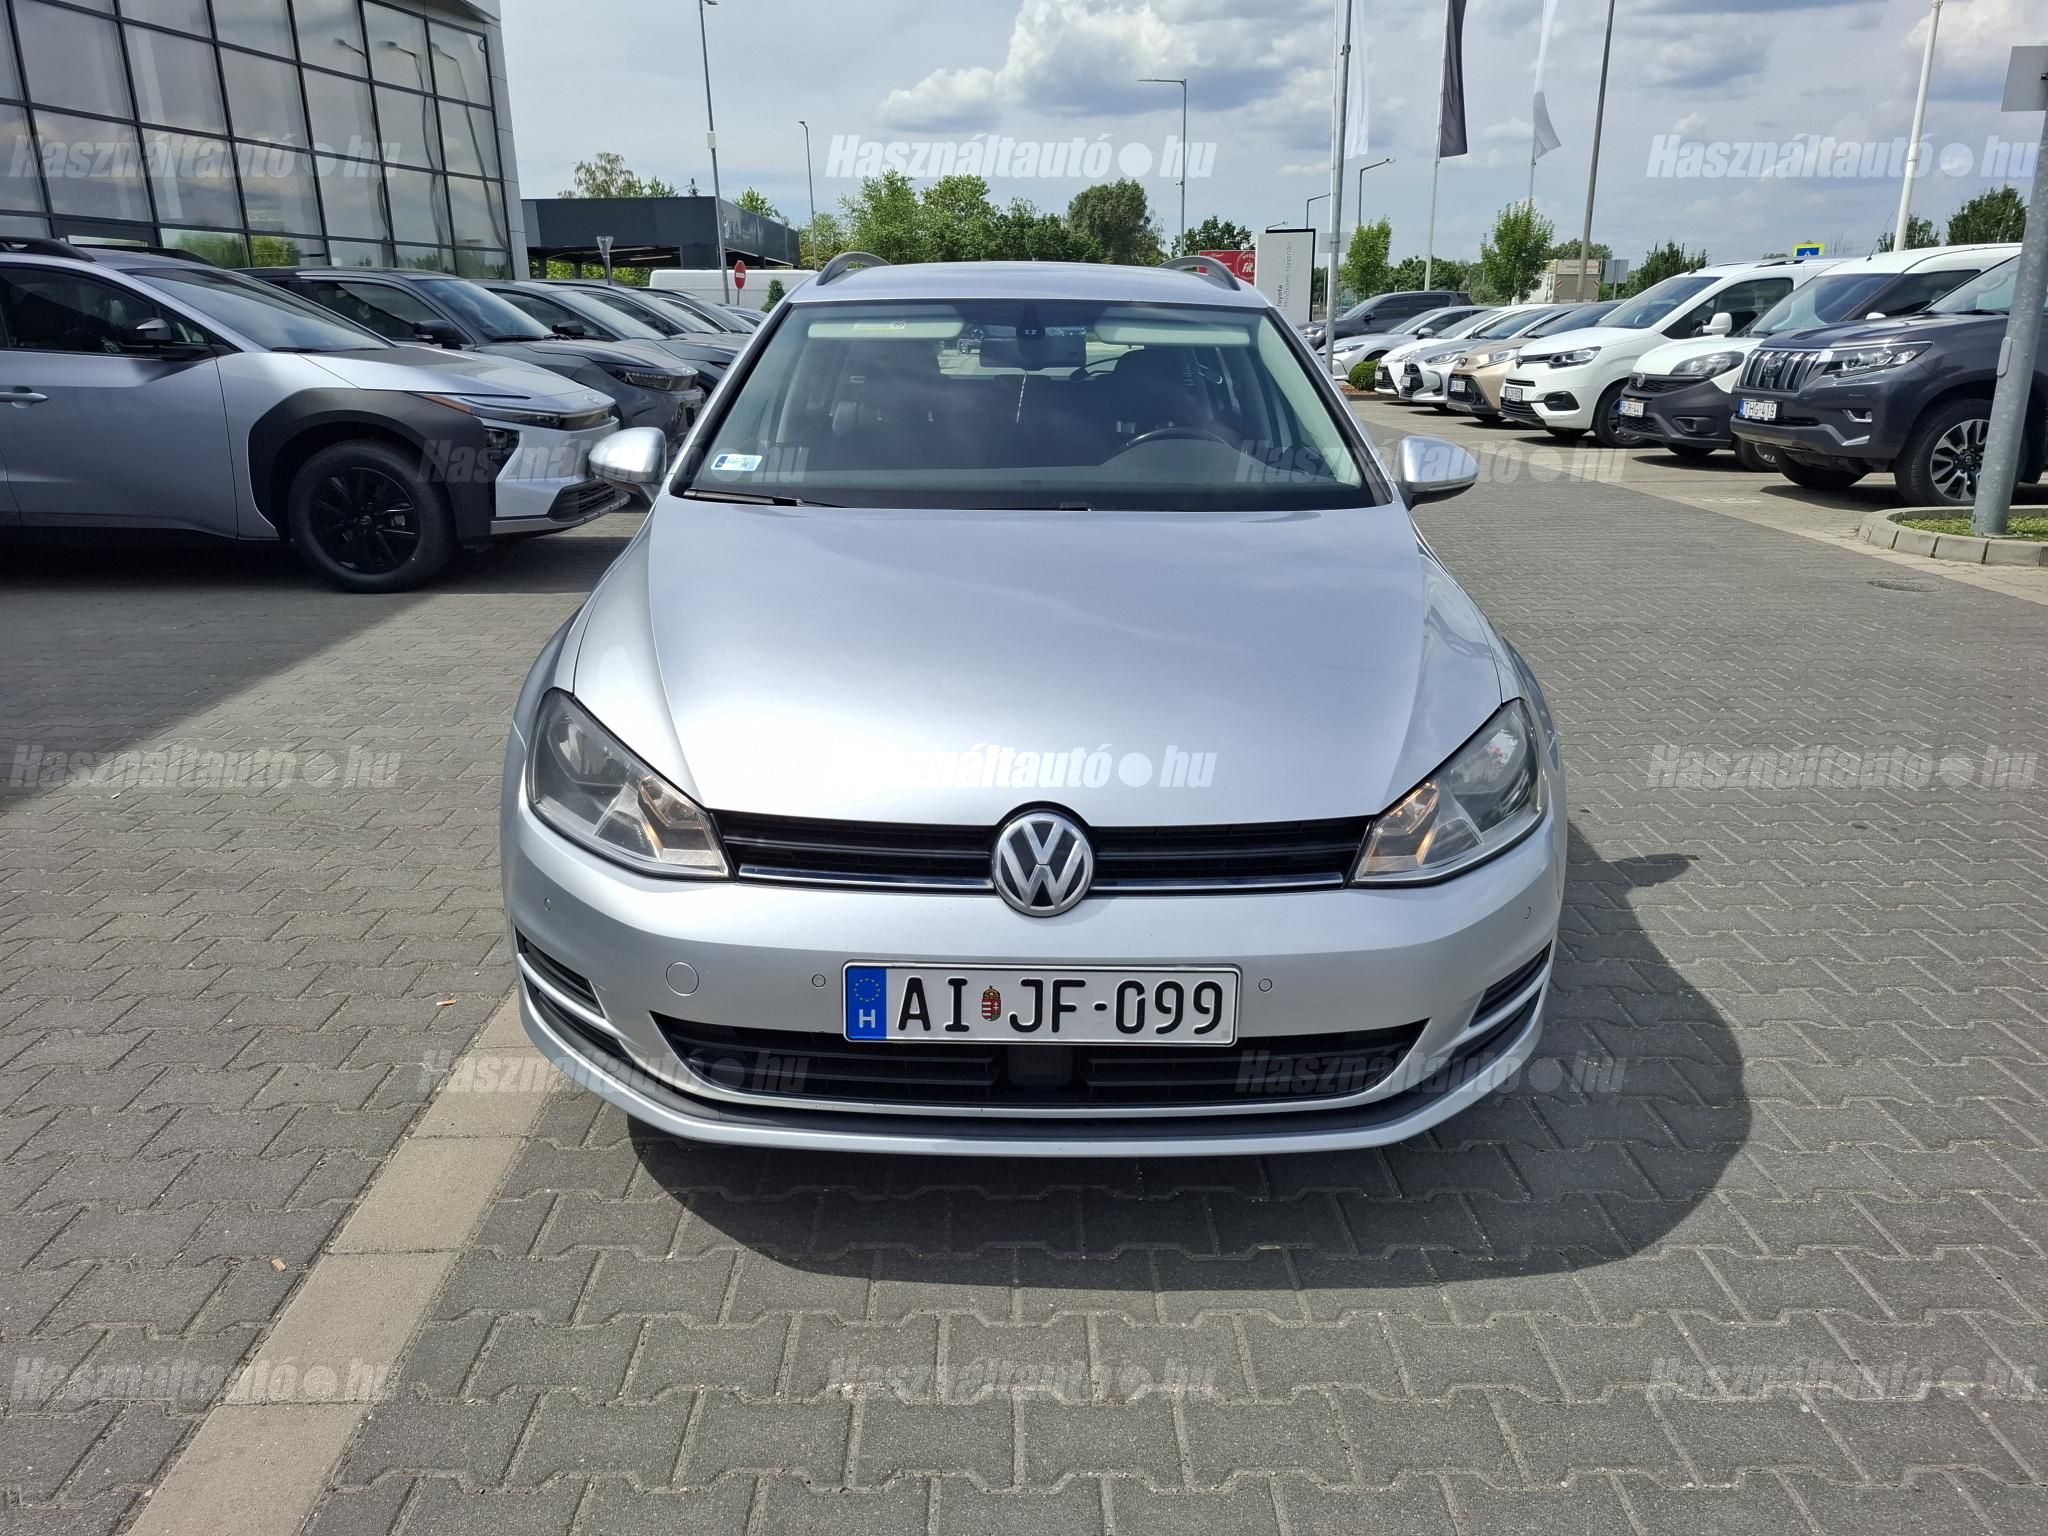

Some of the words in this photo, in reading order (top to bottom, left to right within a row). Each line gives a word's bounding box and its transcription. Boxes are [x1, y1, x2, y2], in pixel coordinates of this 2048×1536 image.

[1745, 402, 1776, 417] THG-419
[896, 976, 970, 1033] AI
[1009, 977, 1223, 1035] JF-099
[859, 1009, 876, 1029] H
